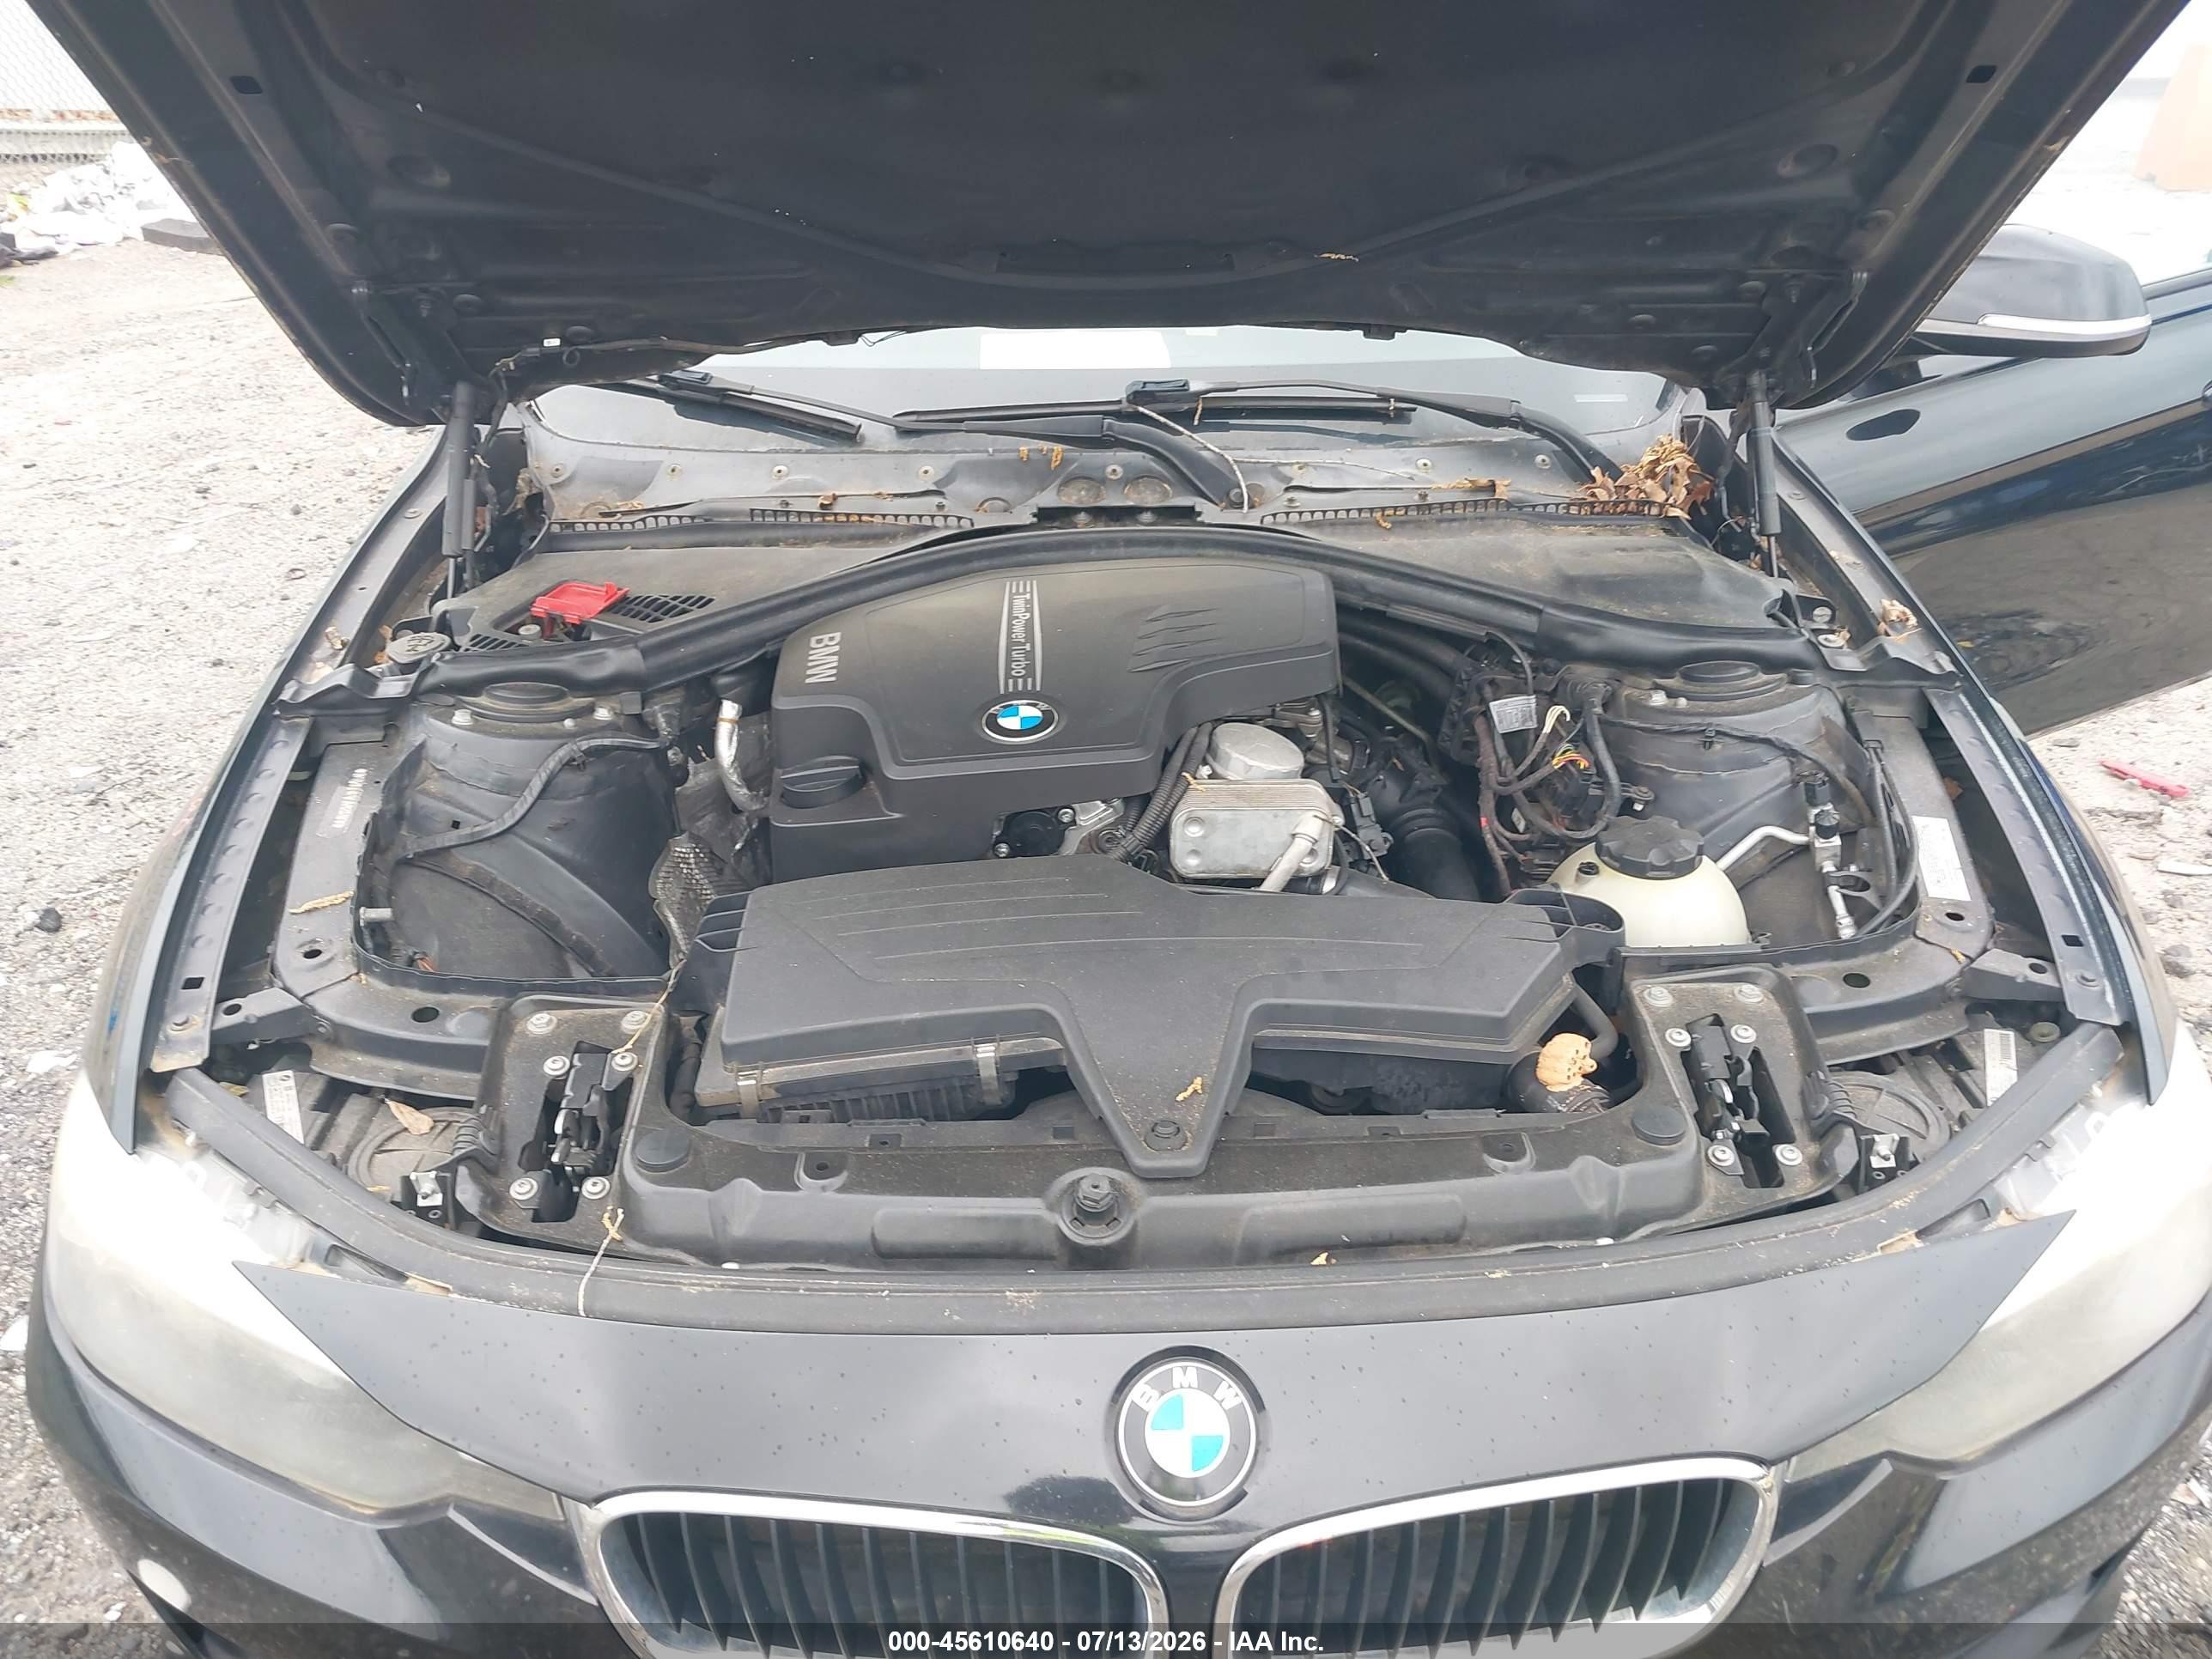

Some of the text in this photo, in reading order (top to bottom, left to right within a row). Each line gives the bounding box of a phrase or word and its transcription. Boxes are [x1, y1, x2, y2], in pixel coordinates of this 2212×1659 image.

[805, 631, 842, 684] BMW
[1011, 593, 1031, 677] TwinPower Turbo
[1131, 1365, 1243, 1413] BMW
